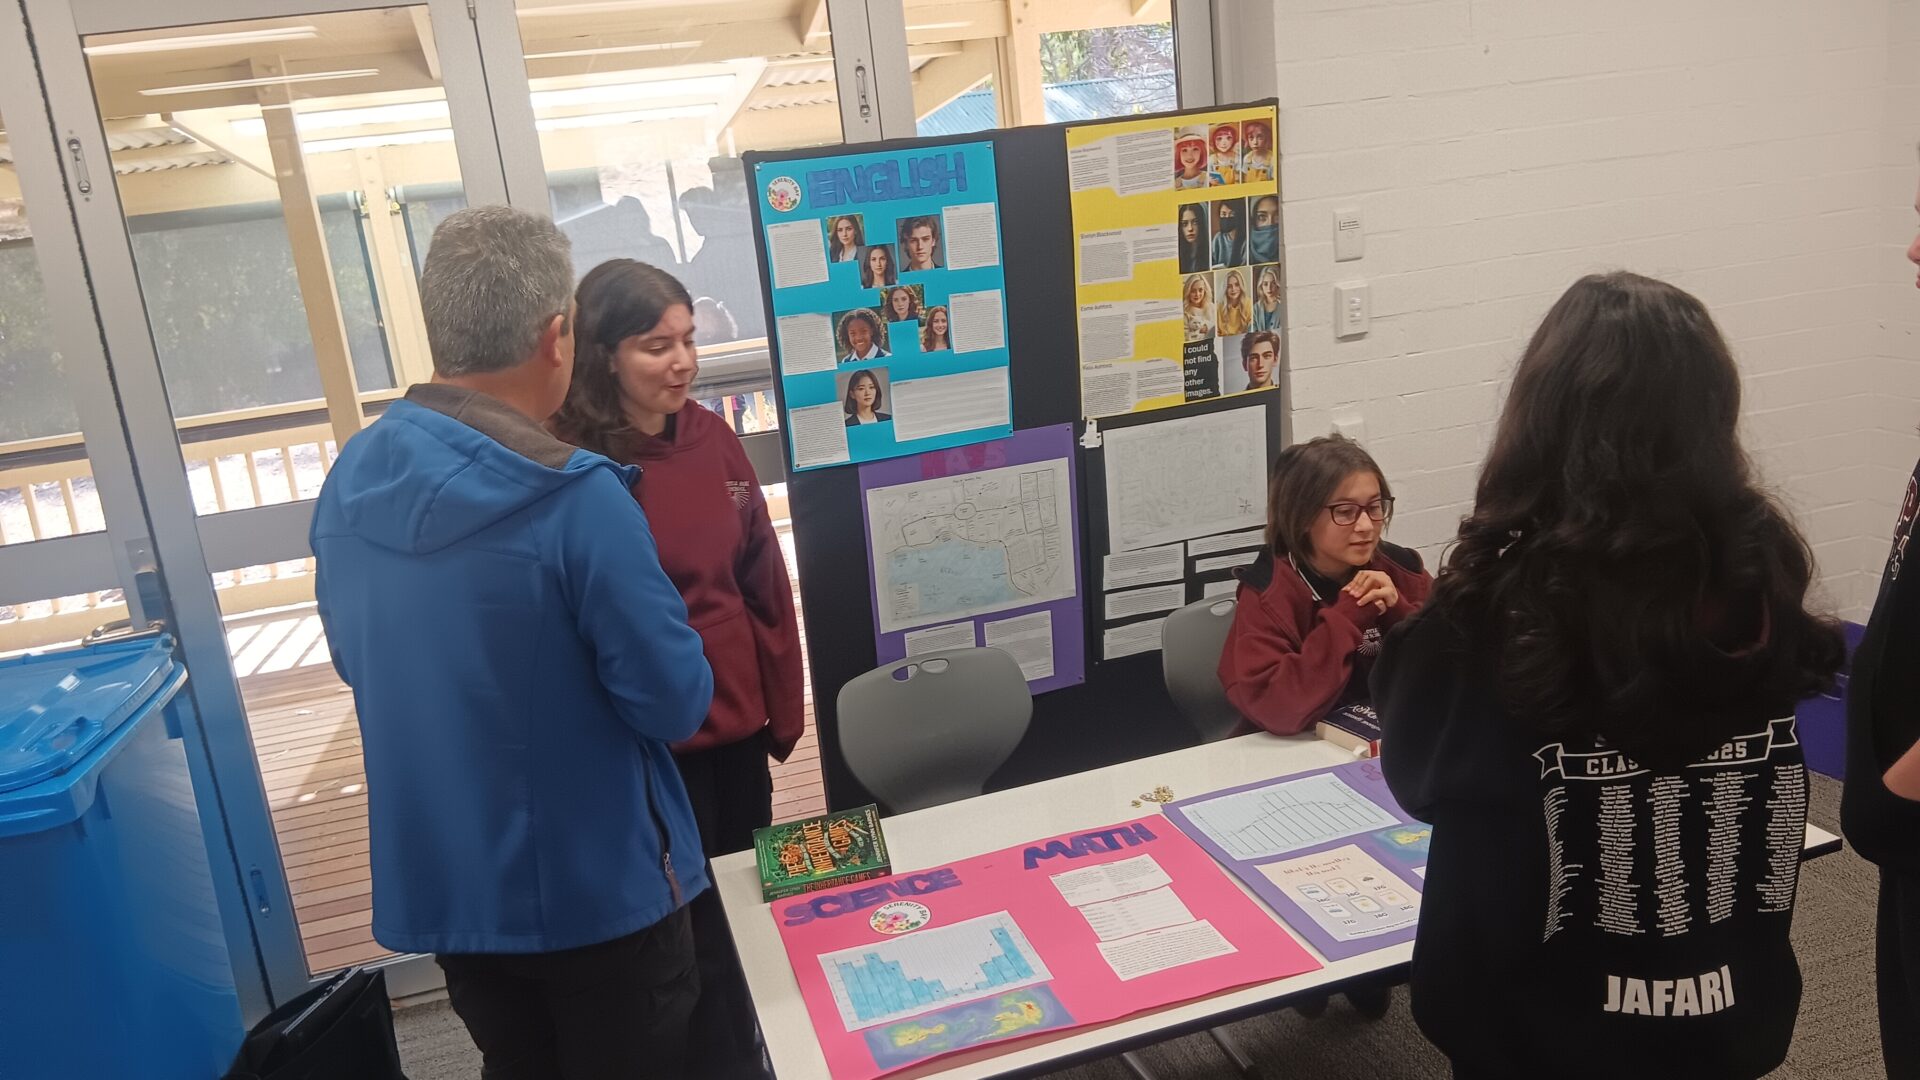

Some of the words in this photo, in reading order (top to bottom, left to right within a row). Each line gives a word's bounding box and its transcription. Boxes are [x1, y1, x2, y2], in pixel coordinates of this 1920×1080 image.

[806, 152, 968, 209] ENGLISH
[1187, 343, 1209, 354] could
[1184, 357, 1197, 365] not
[1197, 354, 1212, 363] find
[1184, 368, 1198, 377] any
[1184, 378, 1205, 387] other
[1185, 388, 1213, 398] images.
[829, 818, 852, 850] GAMES
[1022, 822, 1158, 870] MATH
[786, 859, 808, 878] THE
[784, 868, 963, 927] SCIENCE
[884, 901, 922, 911] SERENITY
[919, 909, 928, 921] BAY
[1603, 964, 1735, 1016] JAFARI
